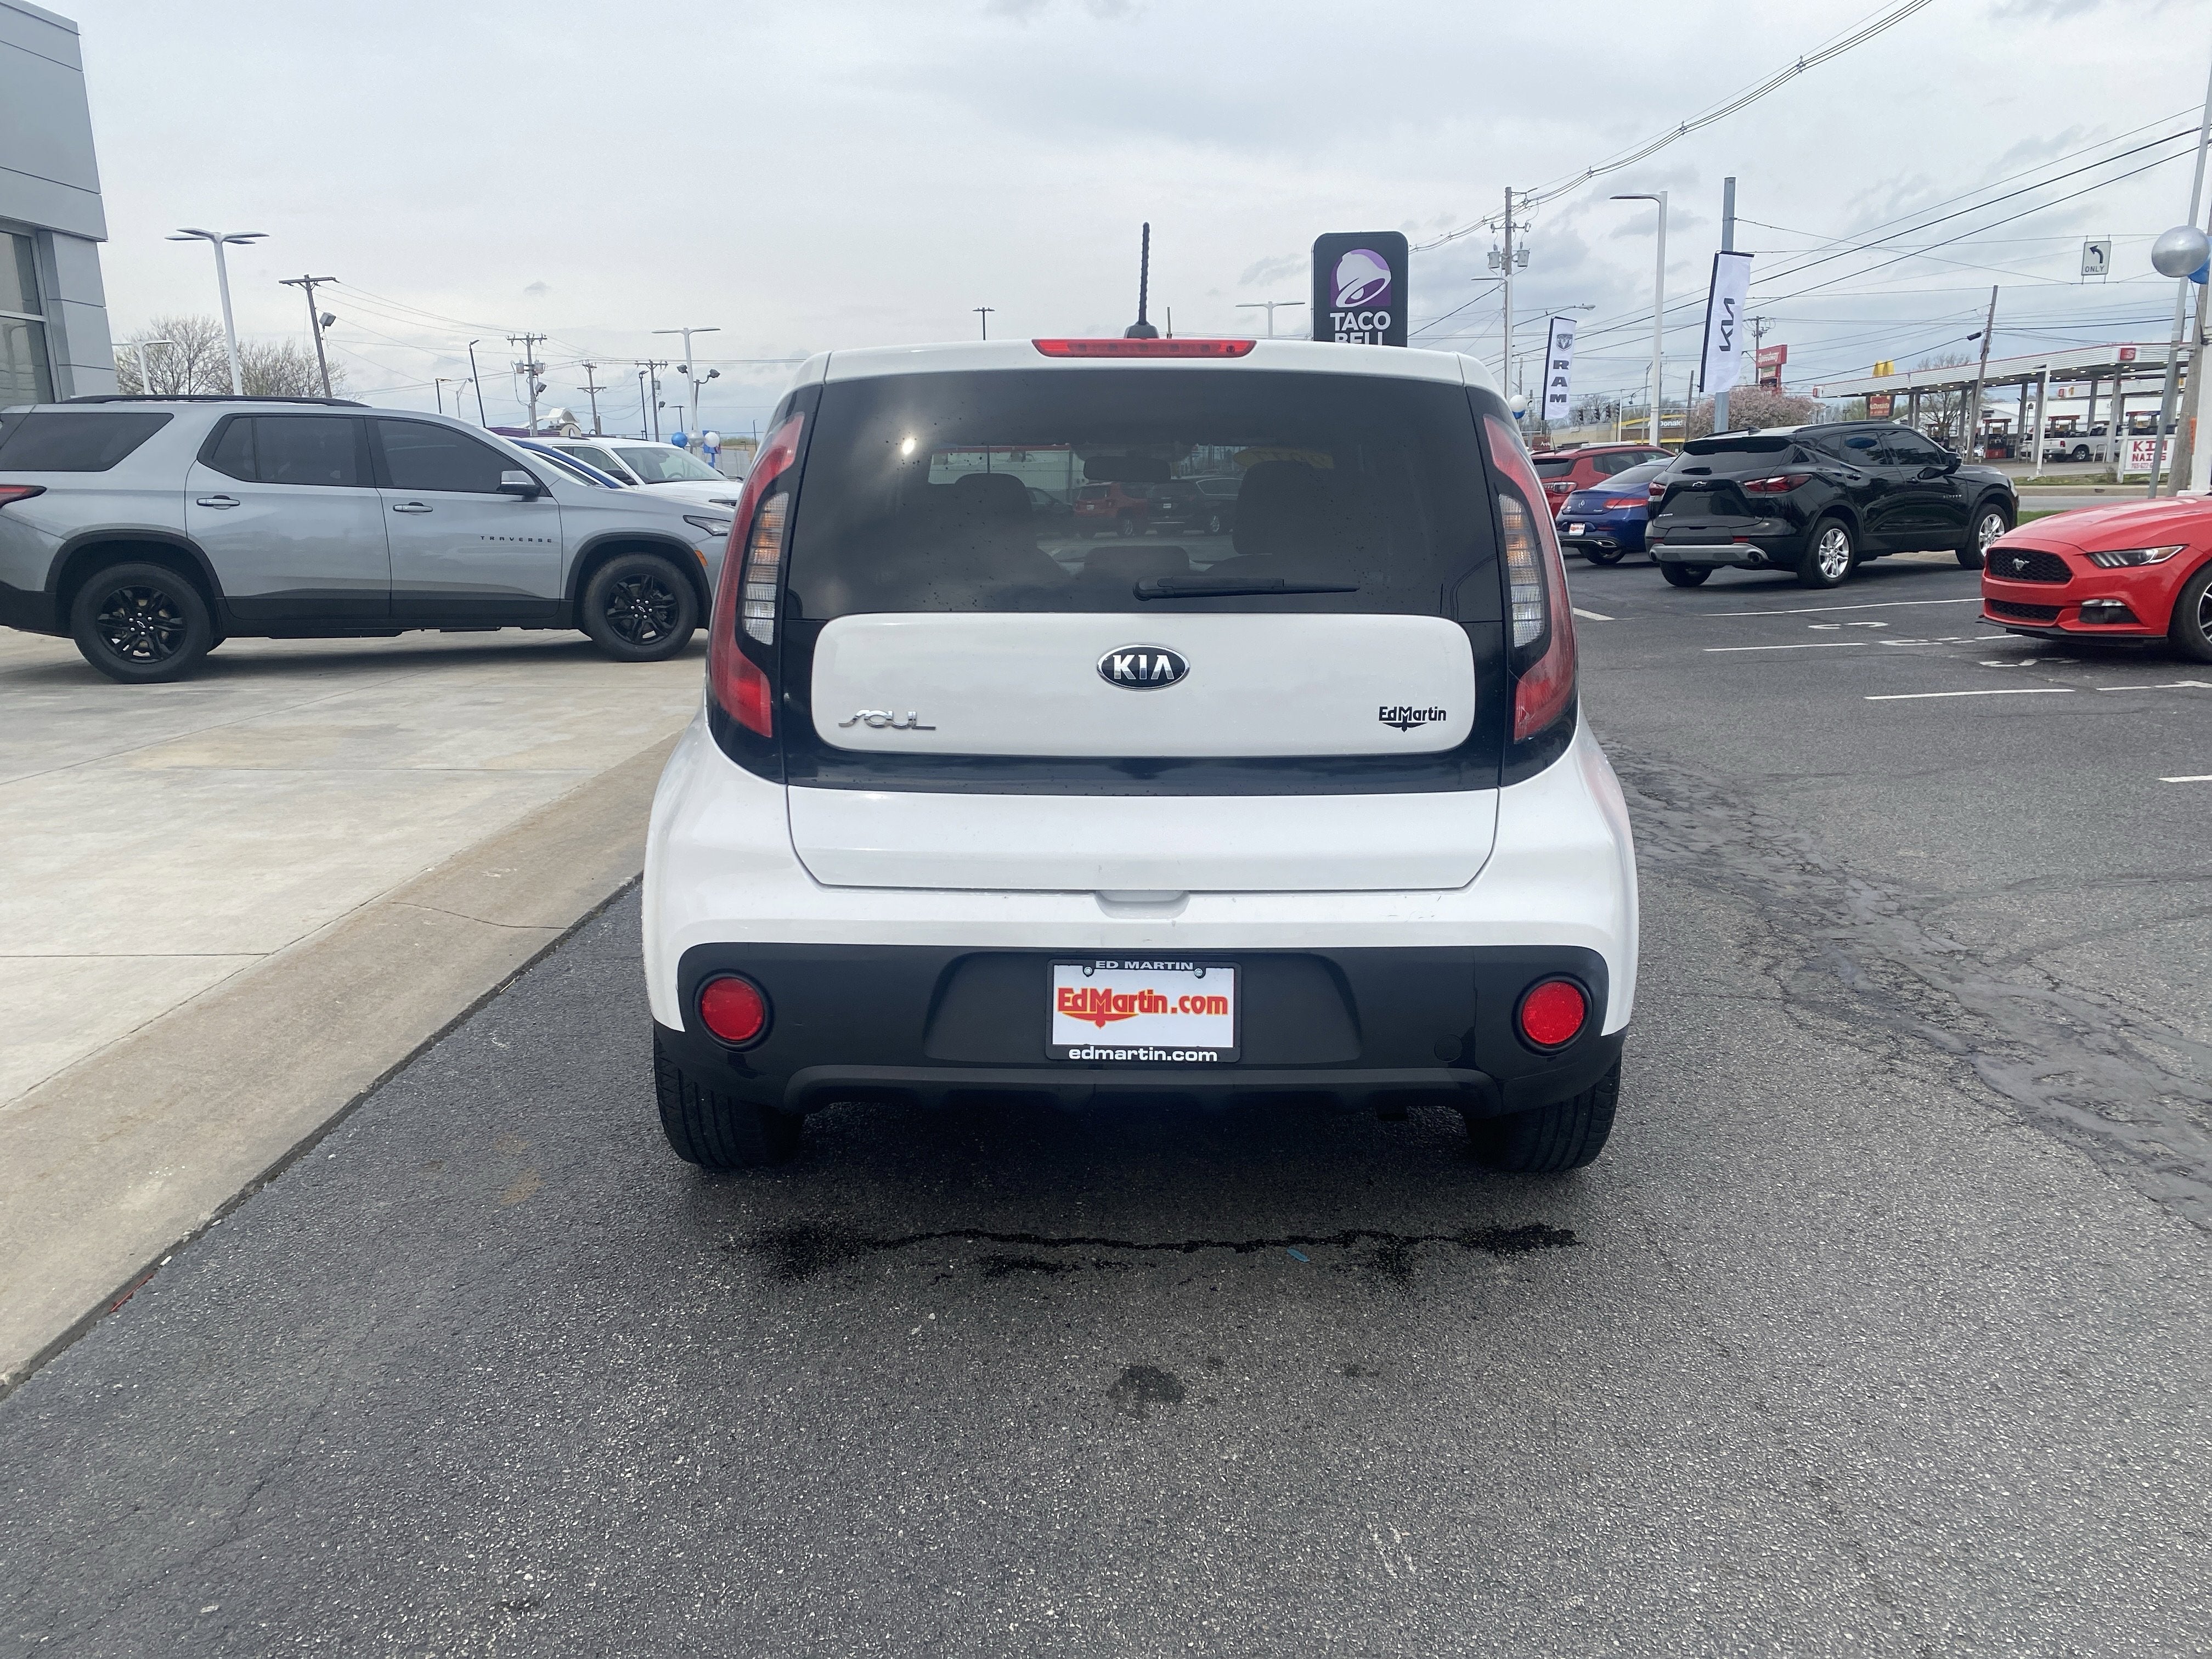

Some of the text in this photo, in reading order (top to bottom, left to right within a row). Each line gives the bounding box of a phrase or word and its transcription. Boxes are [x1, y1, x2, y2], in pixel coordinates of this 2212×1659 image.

[1330, 311, 1391, 331] TACO
[1550, 360, 1570, 403] RAM
[2132, 453, 2166, 461] NAIS
[1113, 654, 1175, 680] KIA
[838, 709, 936, 730] SOUL
[1095, 961, 1194, 970] ED MARTIN
[1069, 1046, 1218, 1062] edmartin.com
